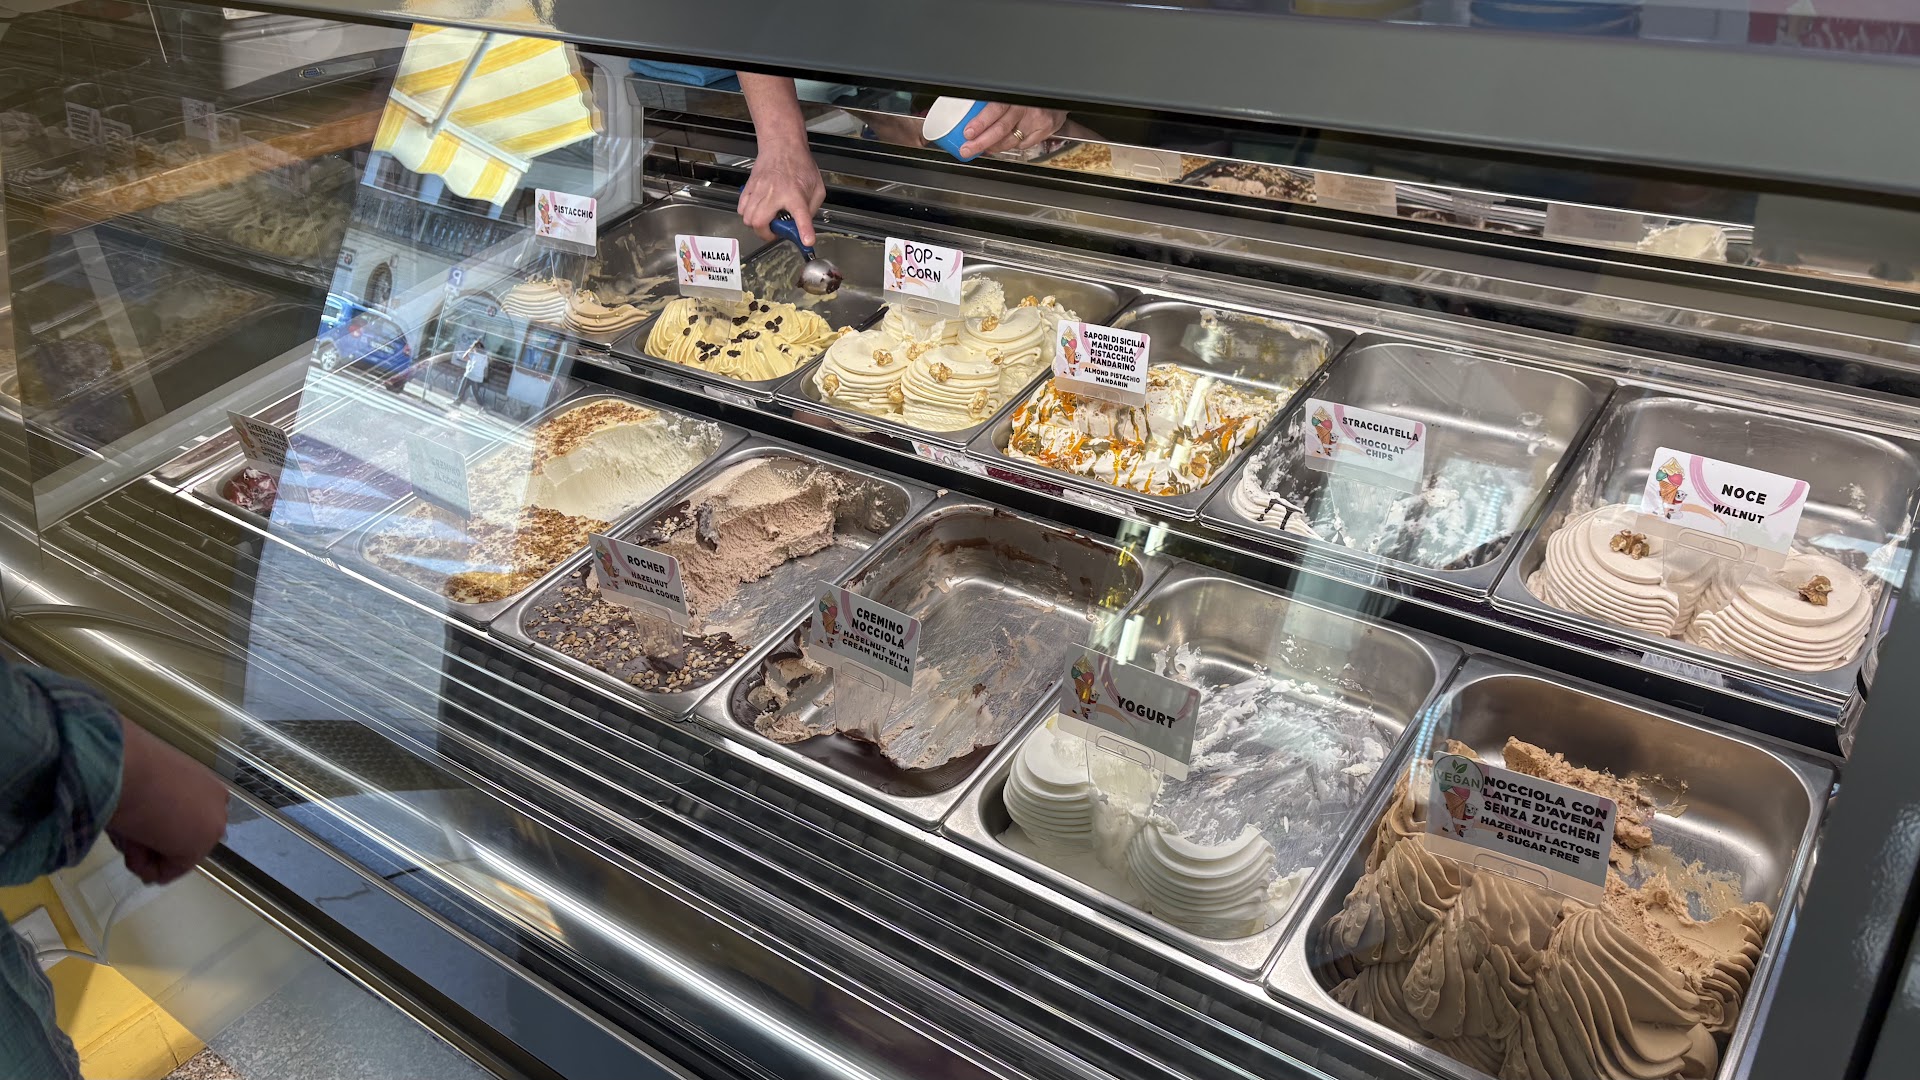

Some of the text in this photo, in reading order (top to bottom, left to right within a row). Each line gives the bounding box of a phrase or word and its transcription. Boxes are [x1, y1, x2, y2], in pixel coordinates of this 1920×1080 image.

[554, 204, 593, 219] PISTACCHIO
[701, 250, 730, 262] MALAGA
[700, 266, 722, 274] VANILLA
[708, 274, 728, 282] RAISINS
[907, 266, 940, 282] CORN
[1084, 331, 1146, 348] SAPORI DI SICILIA
[1092, 341, 1136, 357] MANDORLA,
[1090, 348, 1136, 365] PISTACCHIO,
[1090, 356, 1136, 372] MANDARINO
[1084, 366, 1140, 384] ALMOND PISTACHIO
[1096, 376, 1128, 388] MANDARIN
[245, 422, 286, 441] CHEESECAKE
[1342, 416, 1419, 442] STRACCIATELLA
[1354, 436, 1406, 455] CHOCOLAT
[1366, 448, 1394, 462] CHIPS
[1722, 484, 1768, 506] NOCE
[1713, 503, 1765, 524] WALNUT
[627, 554, 666, 575] ROCHER
[624, 578, 680, 603] NUTELLA COOKIE
[631, 572, 668, 589] HAZELNUT
[856, 608, 904, 635] CREMINO
[852, 618, 904, 650] NOCCIOLA
[842, 638, 909, 673] CREAM NUTELLA
[844, 630, 910, 664] HASELNUT WITH
[1116, 695, 1176, 729] YOGURT
[1436, 769, 1480, 790] VEGAN
[1484, 776, 1608, 820] NOCCIOLA CON
[1482, 788, 1605, 832] LATTE D'AVENA
[1484, 800, 1600, 844] SENZA ZUCCHERI
[1480, 816, 1600, 860] HAZELNUT LACTOSE
[1496, 832, 1580, 864] & SUGAR FREE
